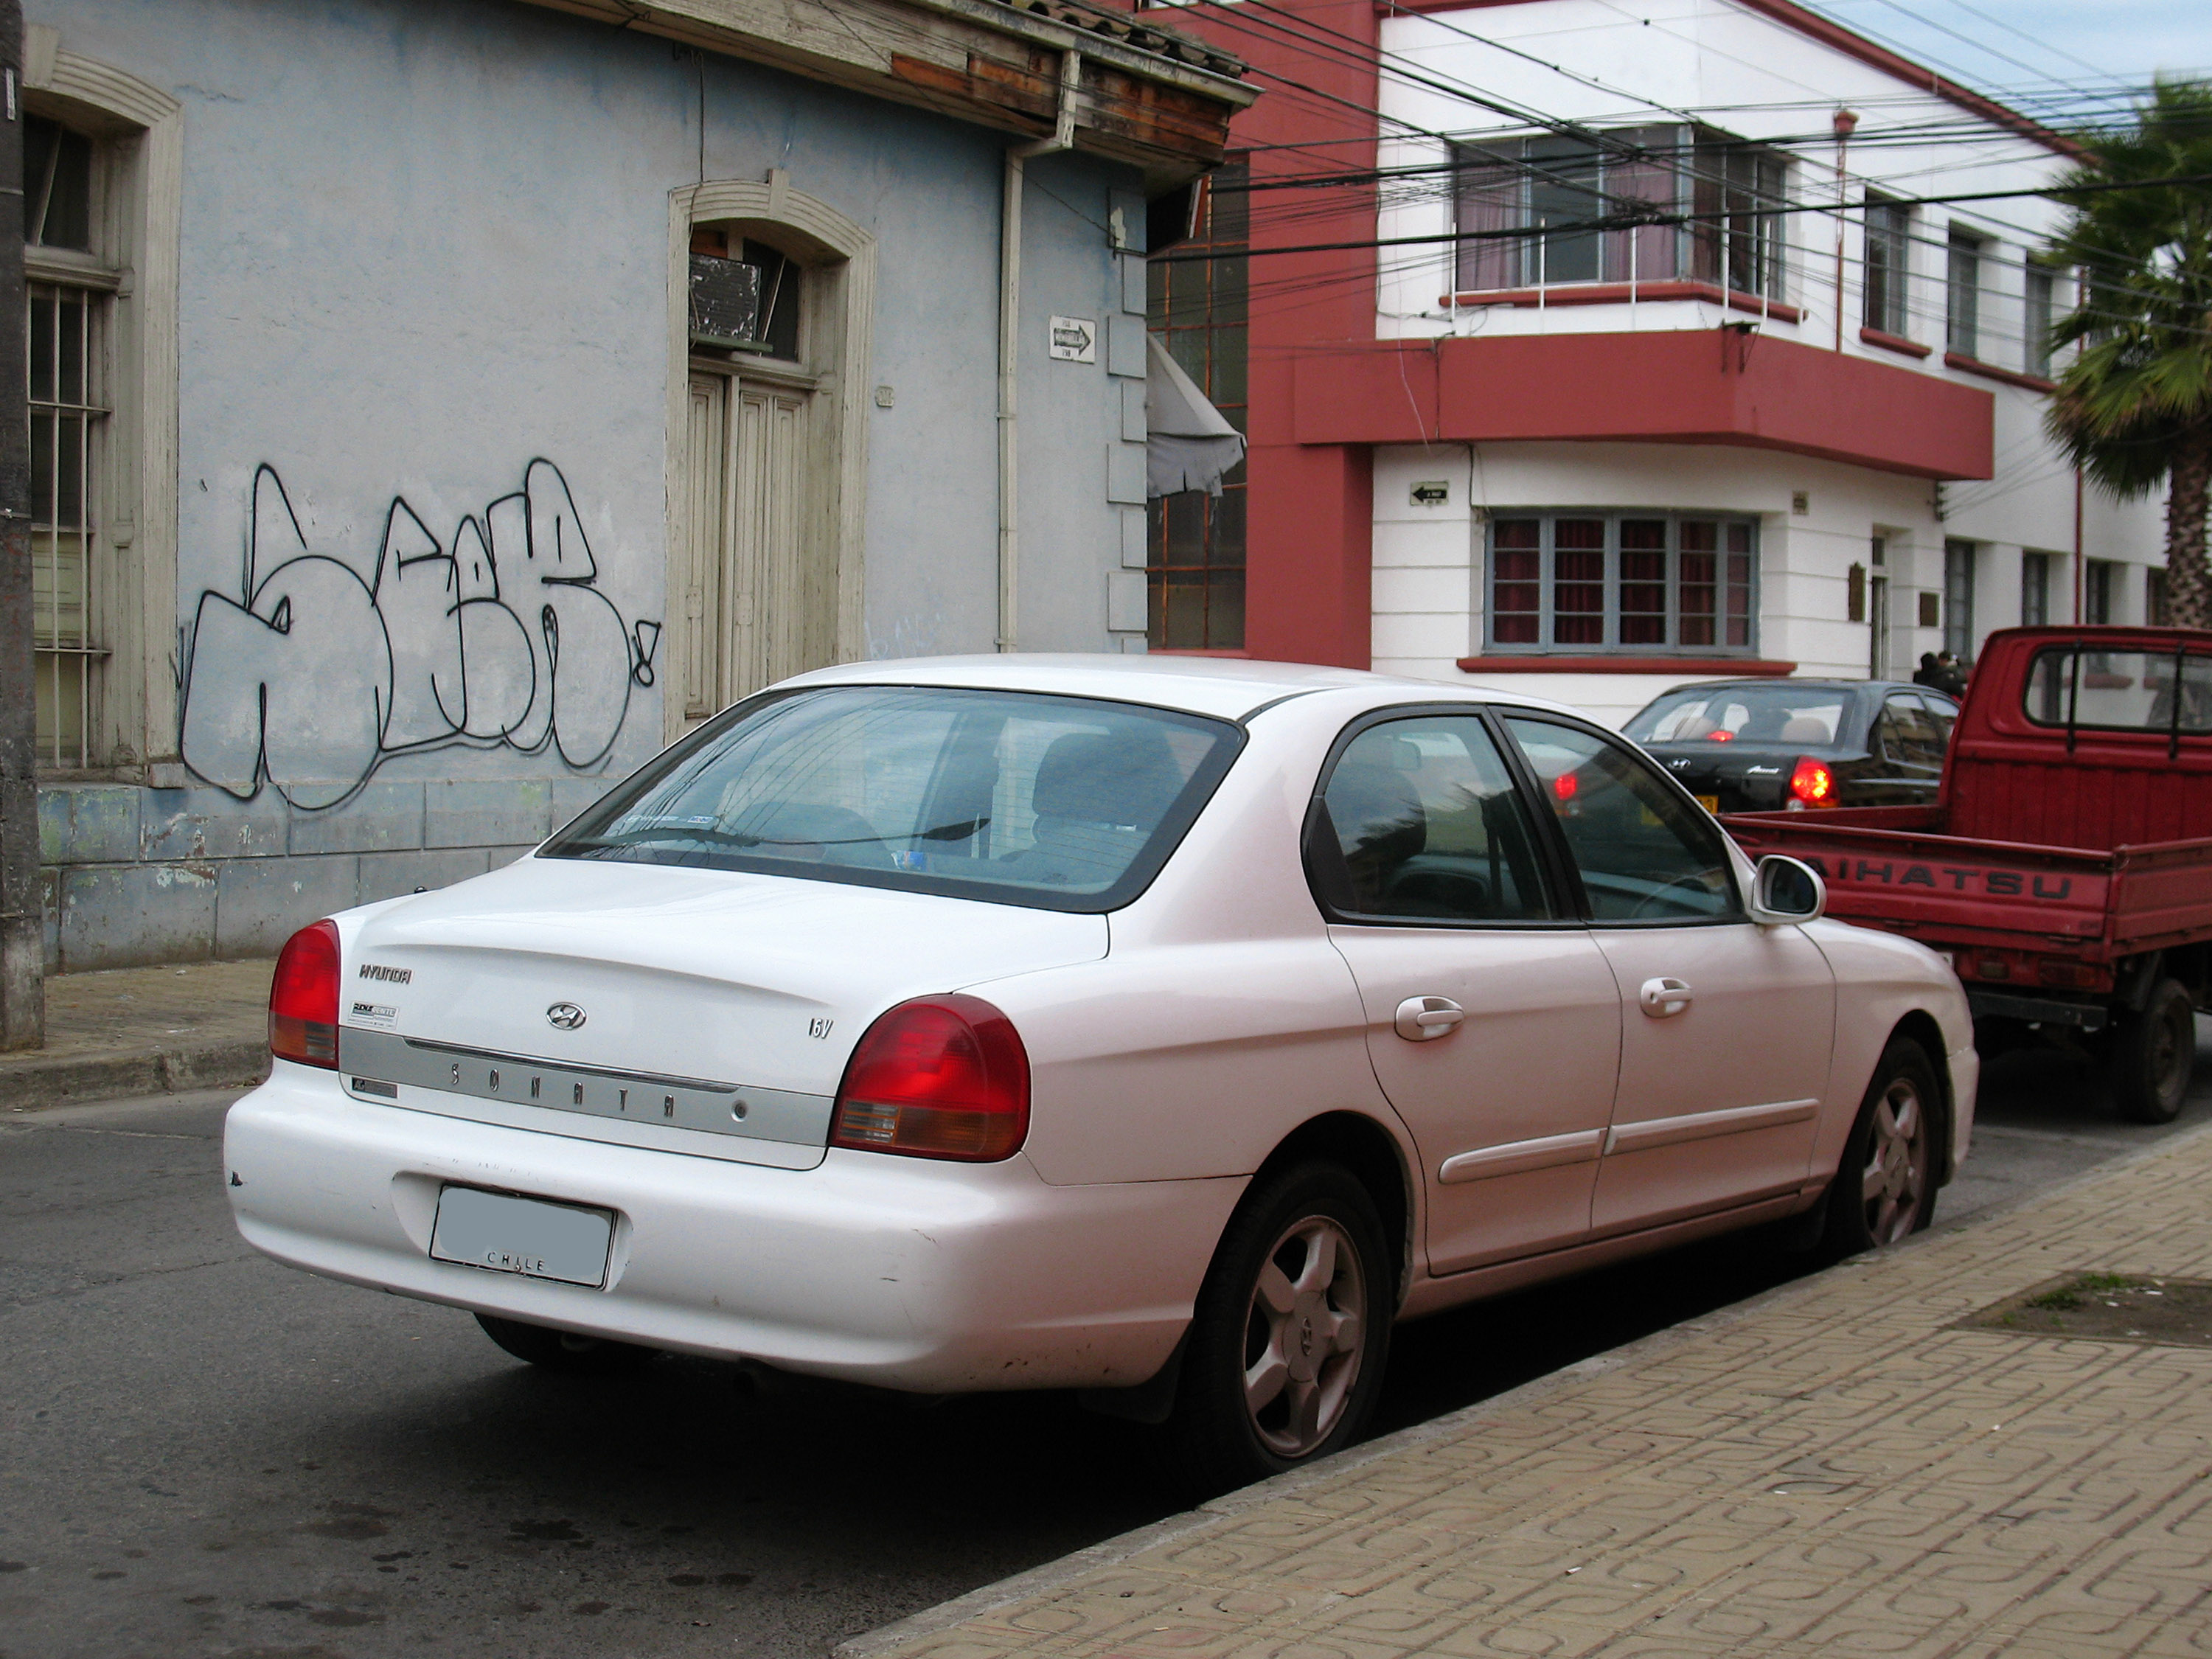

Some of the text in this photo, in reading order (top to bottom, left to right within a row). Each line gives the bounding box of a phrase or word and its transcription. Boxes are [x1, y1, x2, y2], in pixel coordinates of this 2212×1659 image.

[1804, 857, 2071, 899] AIHATSU
[808, 1018, 834, 1039] 16V
[451, 1062, 674, 1118] SONATA
[487, 1252, 544, 1272] CHILE
